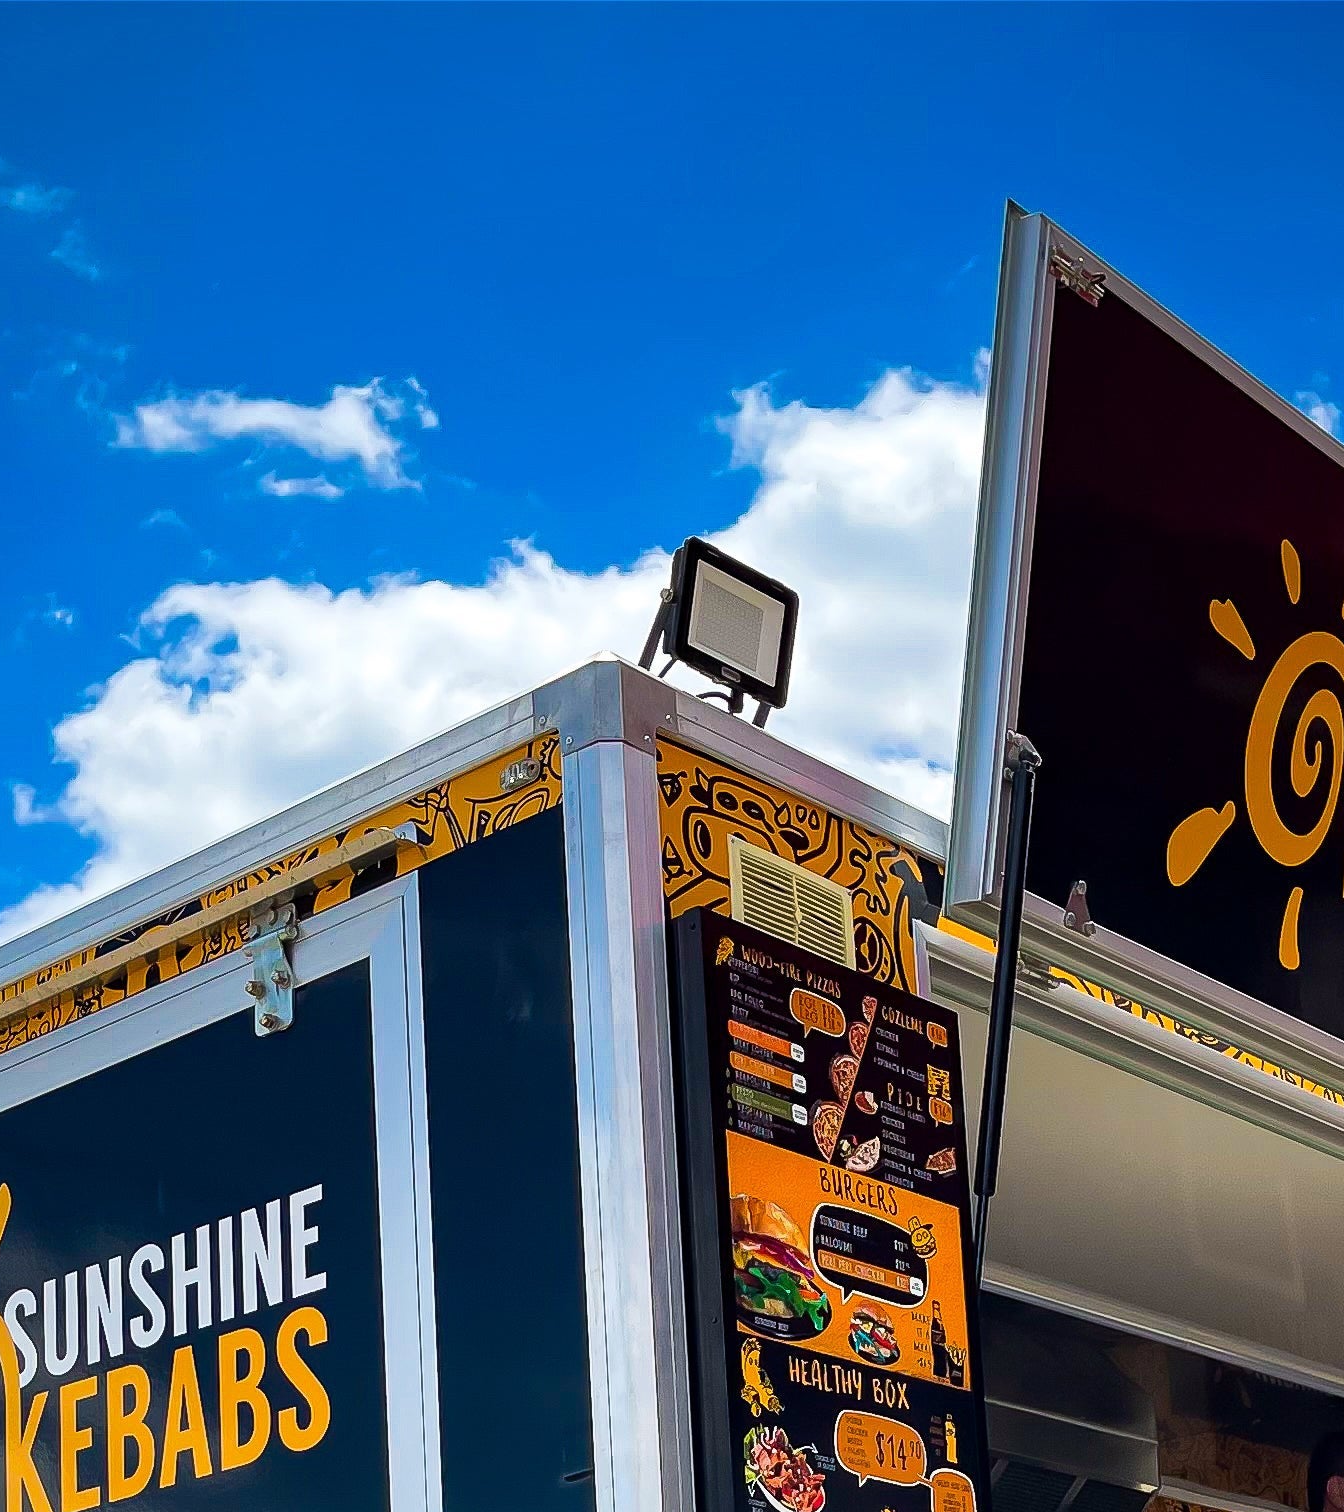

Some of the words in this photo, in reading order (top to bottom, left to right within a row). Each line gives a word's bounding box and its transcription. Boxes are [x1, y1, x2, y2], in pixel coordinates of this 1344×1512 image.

[806, 969, 841, 999] PIZZAS
[819, 1167, 898, 1216] BURGERS
[3, 1183, 327, 1389] SUNSHINE
[788, 1355, 862, 1400] HEALTHY
[873, 1378, 910, 1410] BOX
